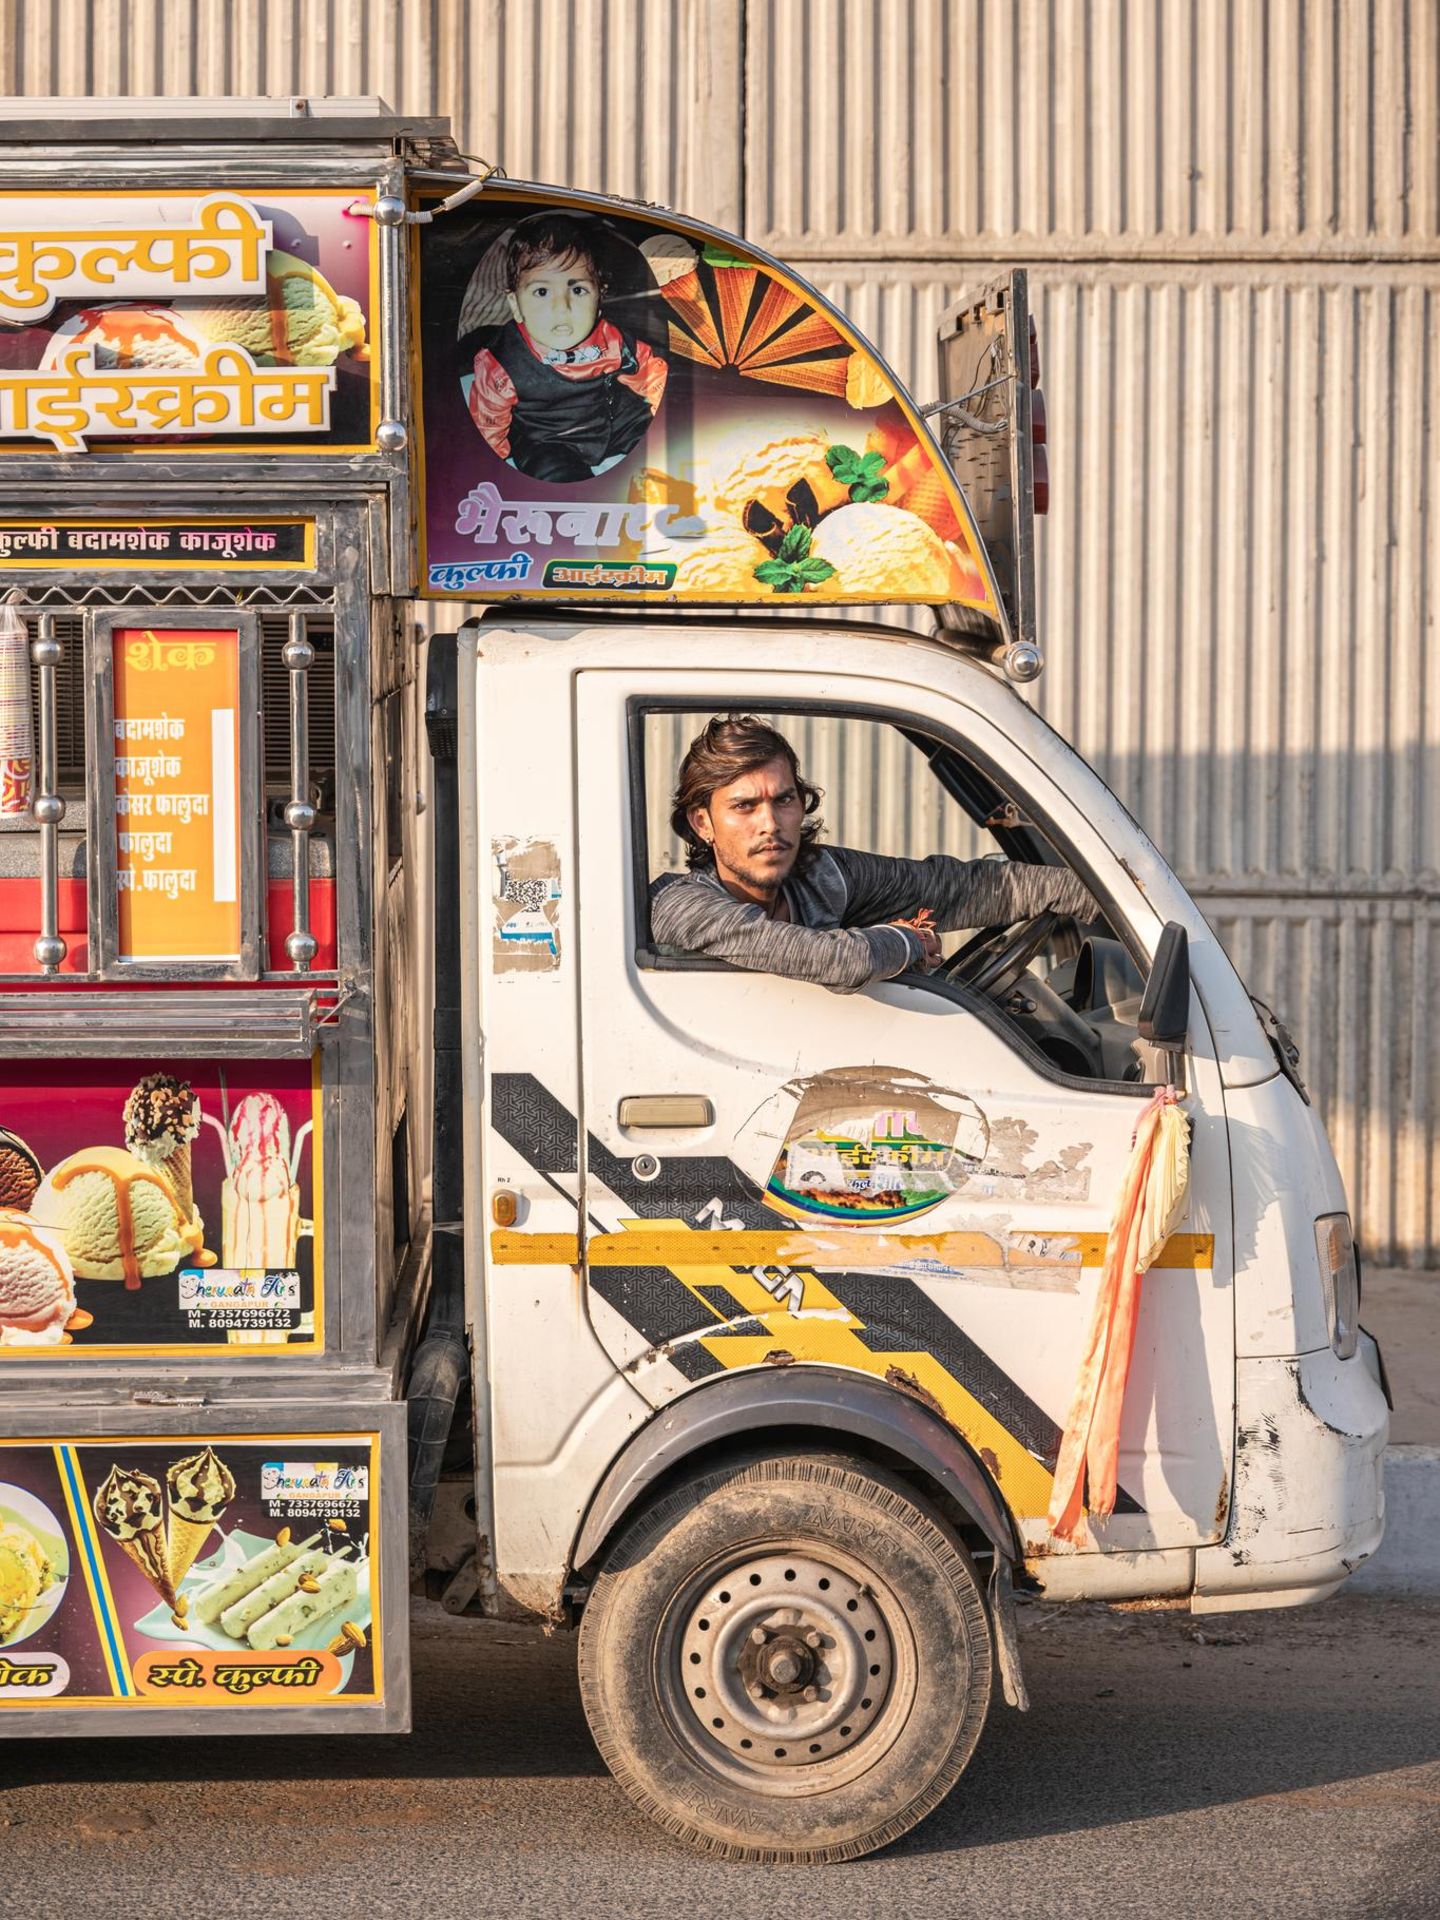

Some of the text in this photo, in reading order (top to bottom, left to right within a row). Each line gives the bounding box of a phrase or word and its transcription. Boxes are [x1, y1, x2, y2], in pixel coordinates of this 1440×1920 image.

[67, 526, 171, 551] बदामशेक
[179, 526, 277, 559] काजूशेक
[429, 551, 668, 591] कुल्फी आईस्क्रीम
[125, 630, 217, 672] शेक
[114, 712, 185, 741] बदामशेक
[115, 750, 182, 786] काजूशेक
[115, 788, 209, 823] केसर फालुदा
[119, 831, 172, 861] फालुदा
[189, 1319, 292, 1328] M. 8094739132
[210, 1310, 291, 1318] 7357696672
[270, 1509, 361, 1517] M. 8094739132
[289, 1500, 360, 1508] 7357696672
[148, 1656, 324, 1695] स्पे. कुल्फी
